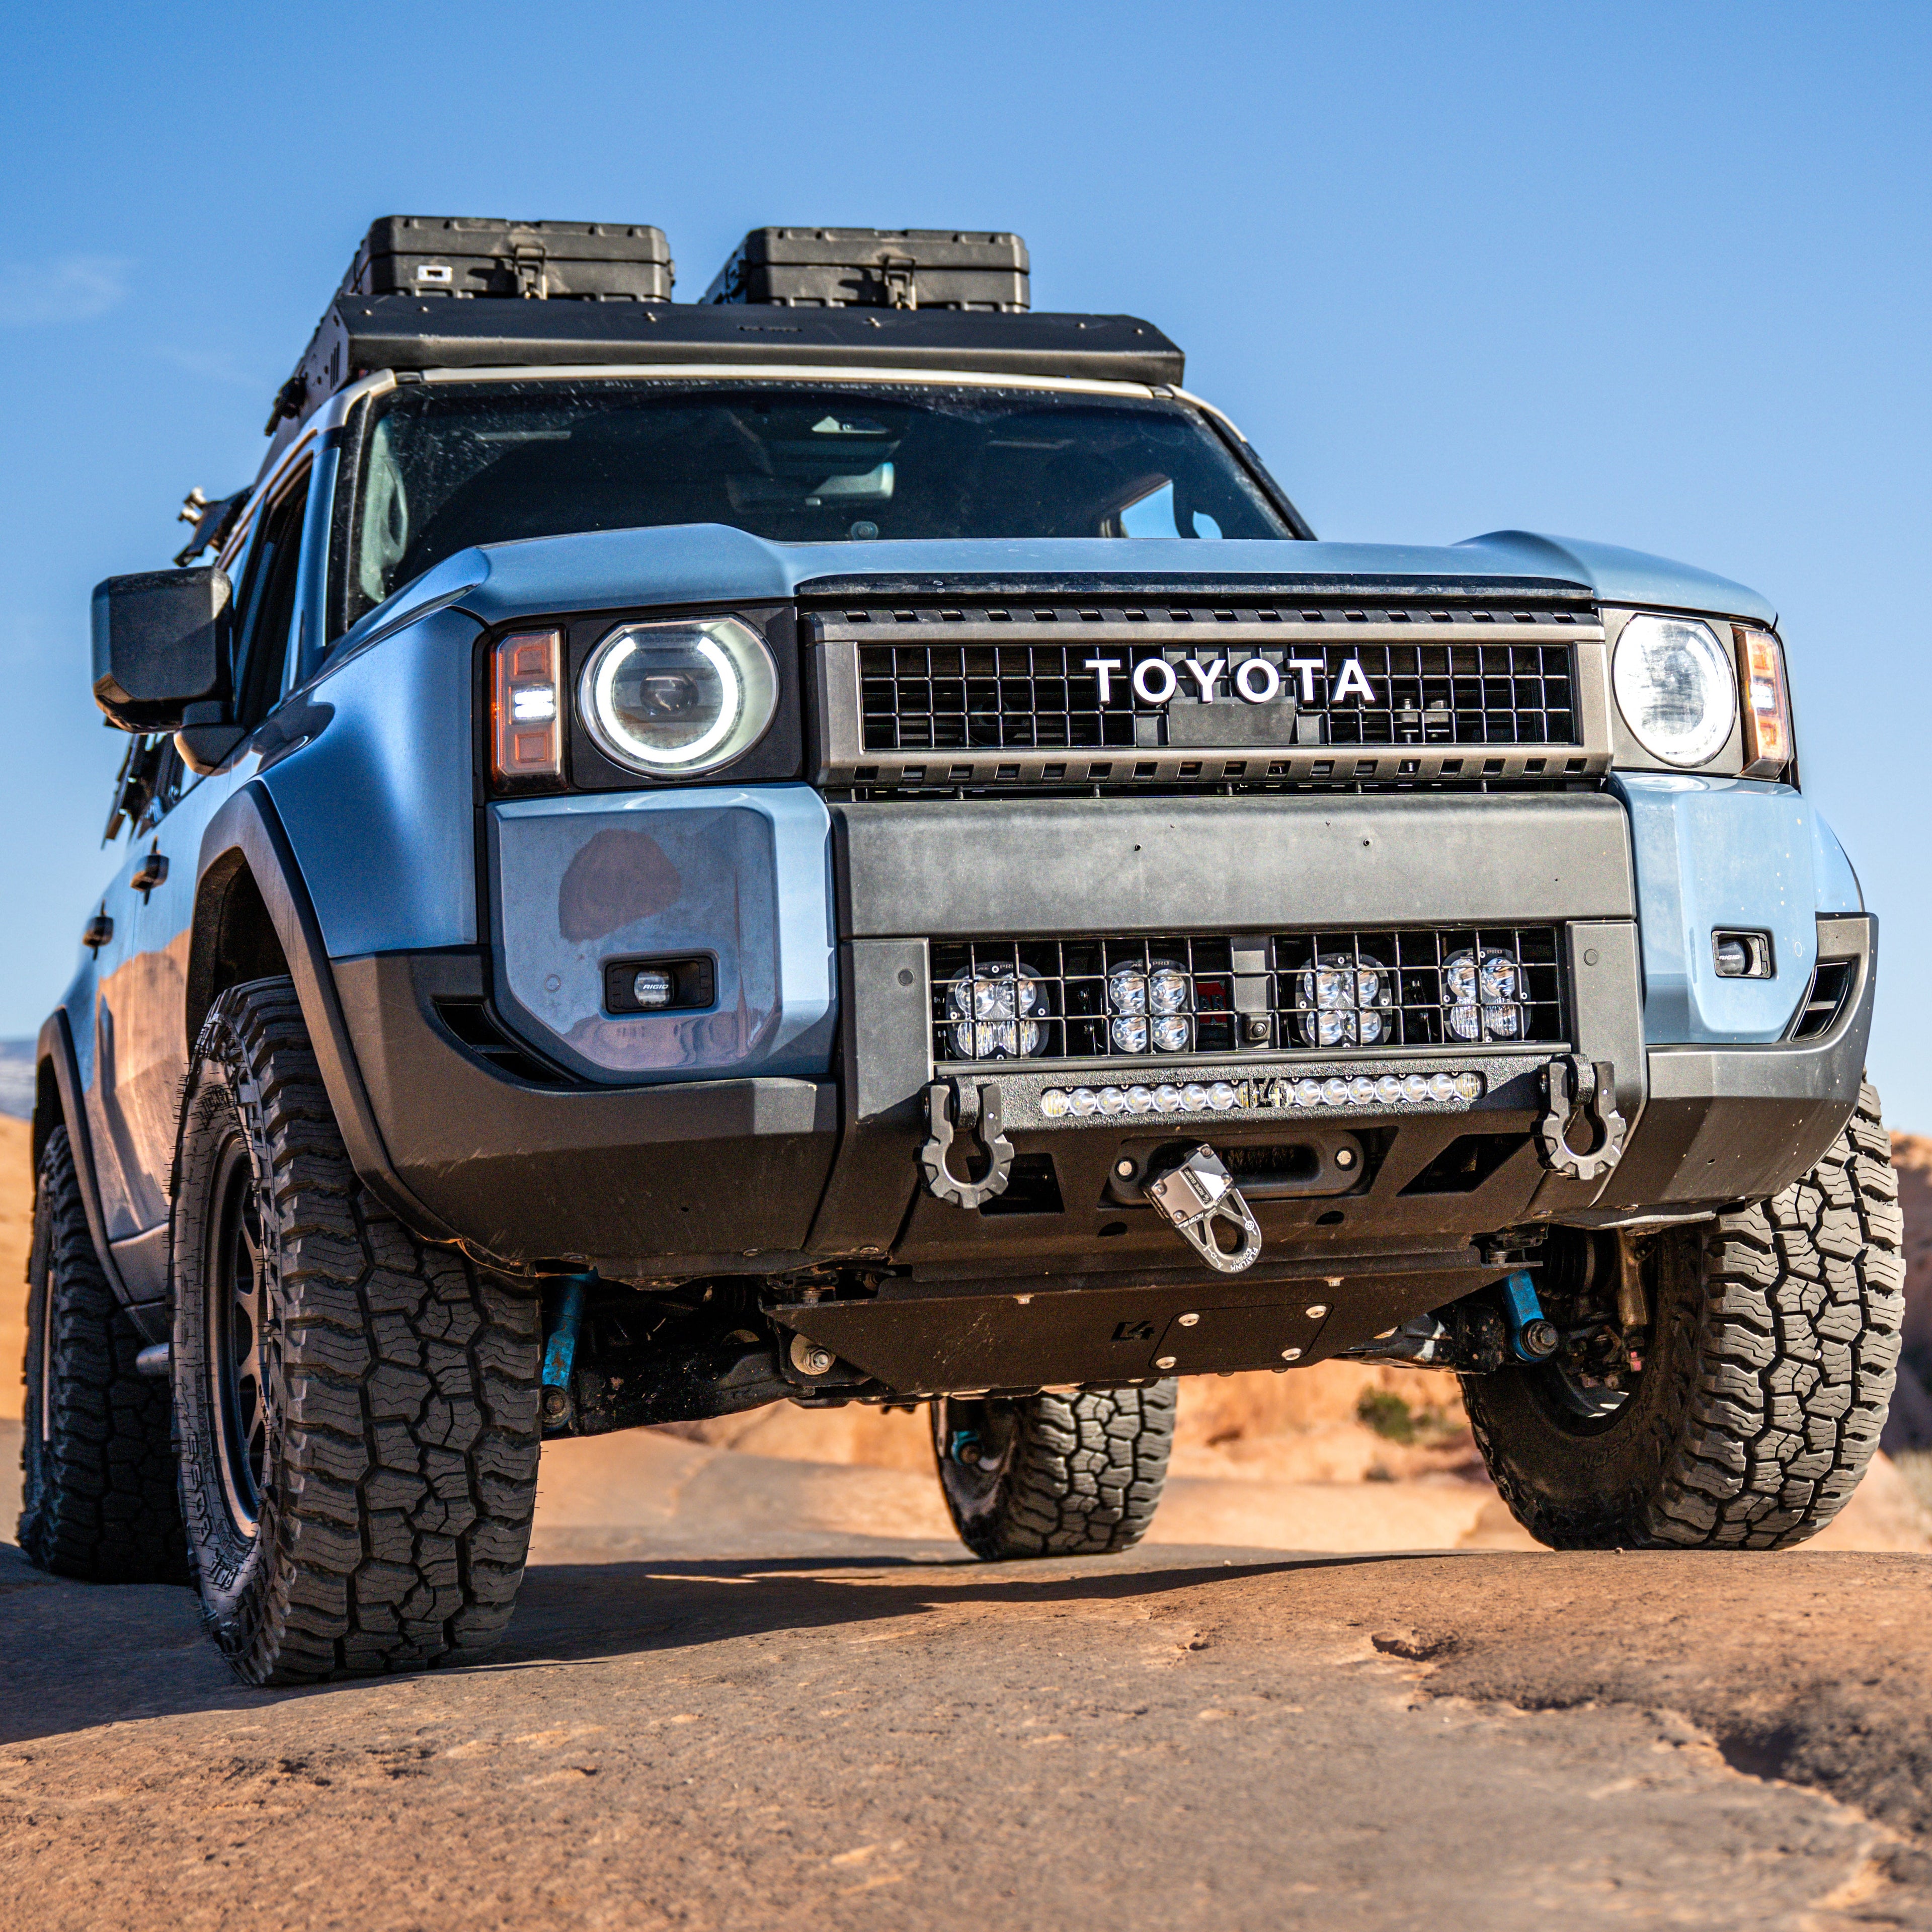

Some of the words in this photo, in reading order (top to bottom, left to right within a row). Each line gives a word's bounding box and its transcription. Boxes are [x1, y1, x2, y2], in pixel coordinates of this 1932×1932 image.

[1083, 658, 1376, 704] TOYOTA
[1184, 1169, 1196, 1184] GUARD
[1194, 1183, 1205, 1195] ROPE
[1188, 1212, 1203, 1224] FACTOR
[1230, 1247, 1258, 1271] FLATLINK
[1233, 1247, 1252, 1265] EXPERT
